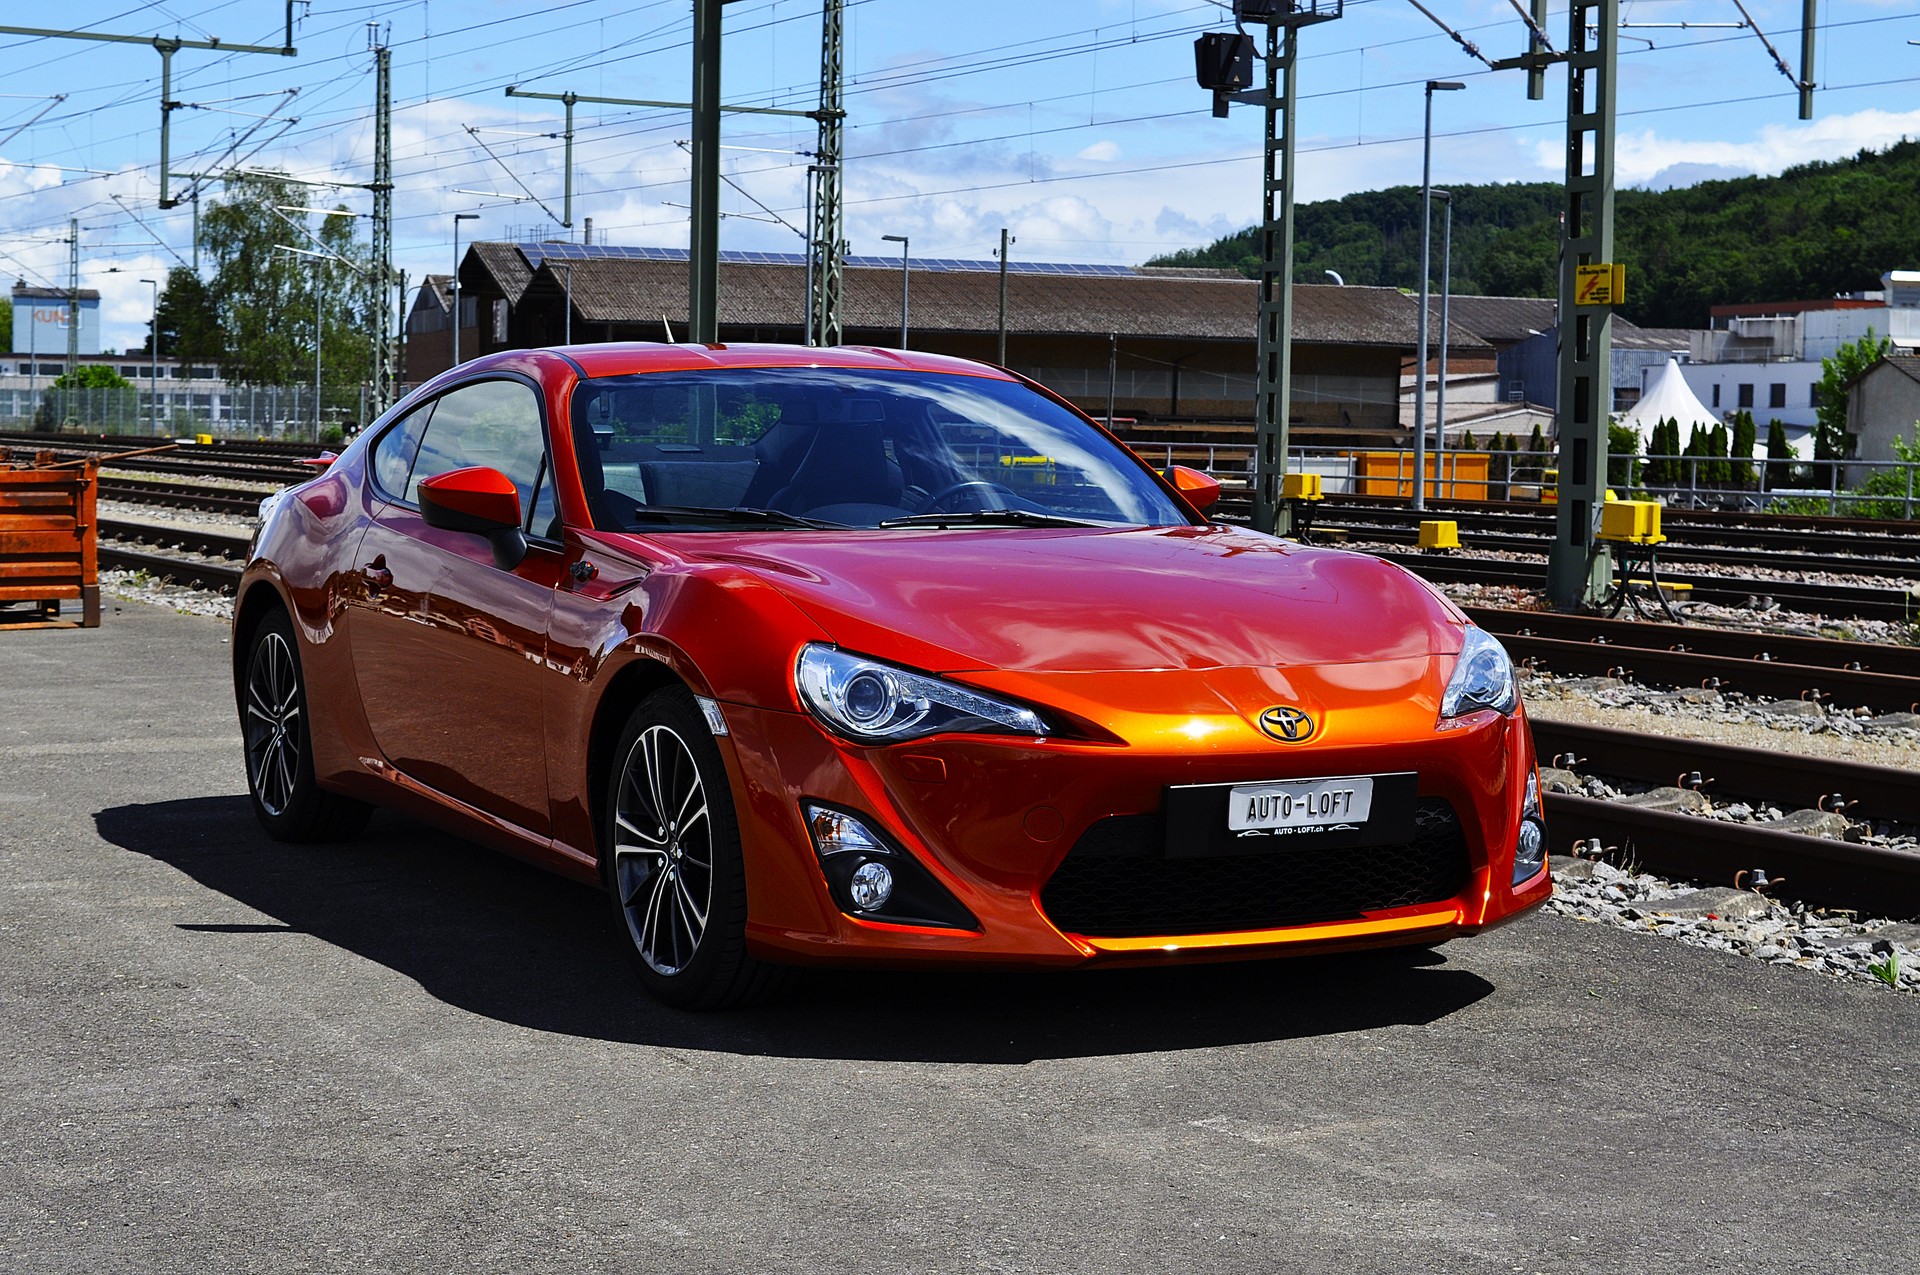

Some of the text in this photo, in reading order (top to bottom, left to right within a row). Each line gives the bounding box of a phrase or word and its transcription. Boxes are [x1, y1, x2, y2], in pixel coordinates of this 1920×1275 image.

[1247, 790, 1354, 820] AUTO-LOFT
[1274, 827, 1293, 835] AUTO
[1297, 826, 1324, 834] LOFT.ch
